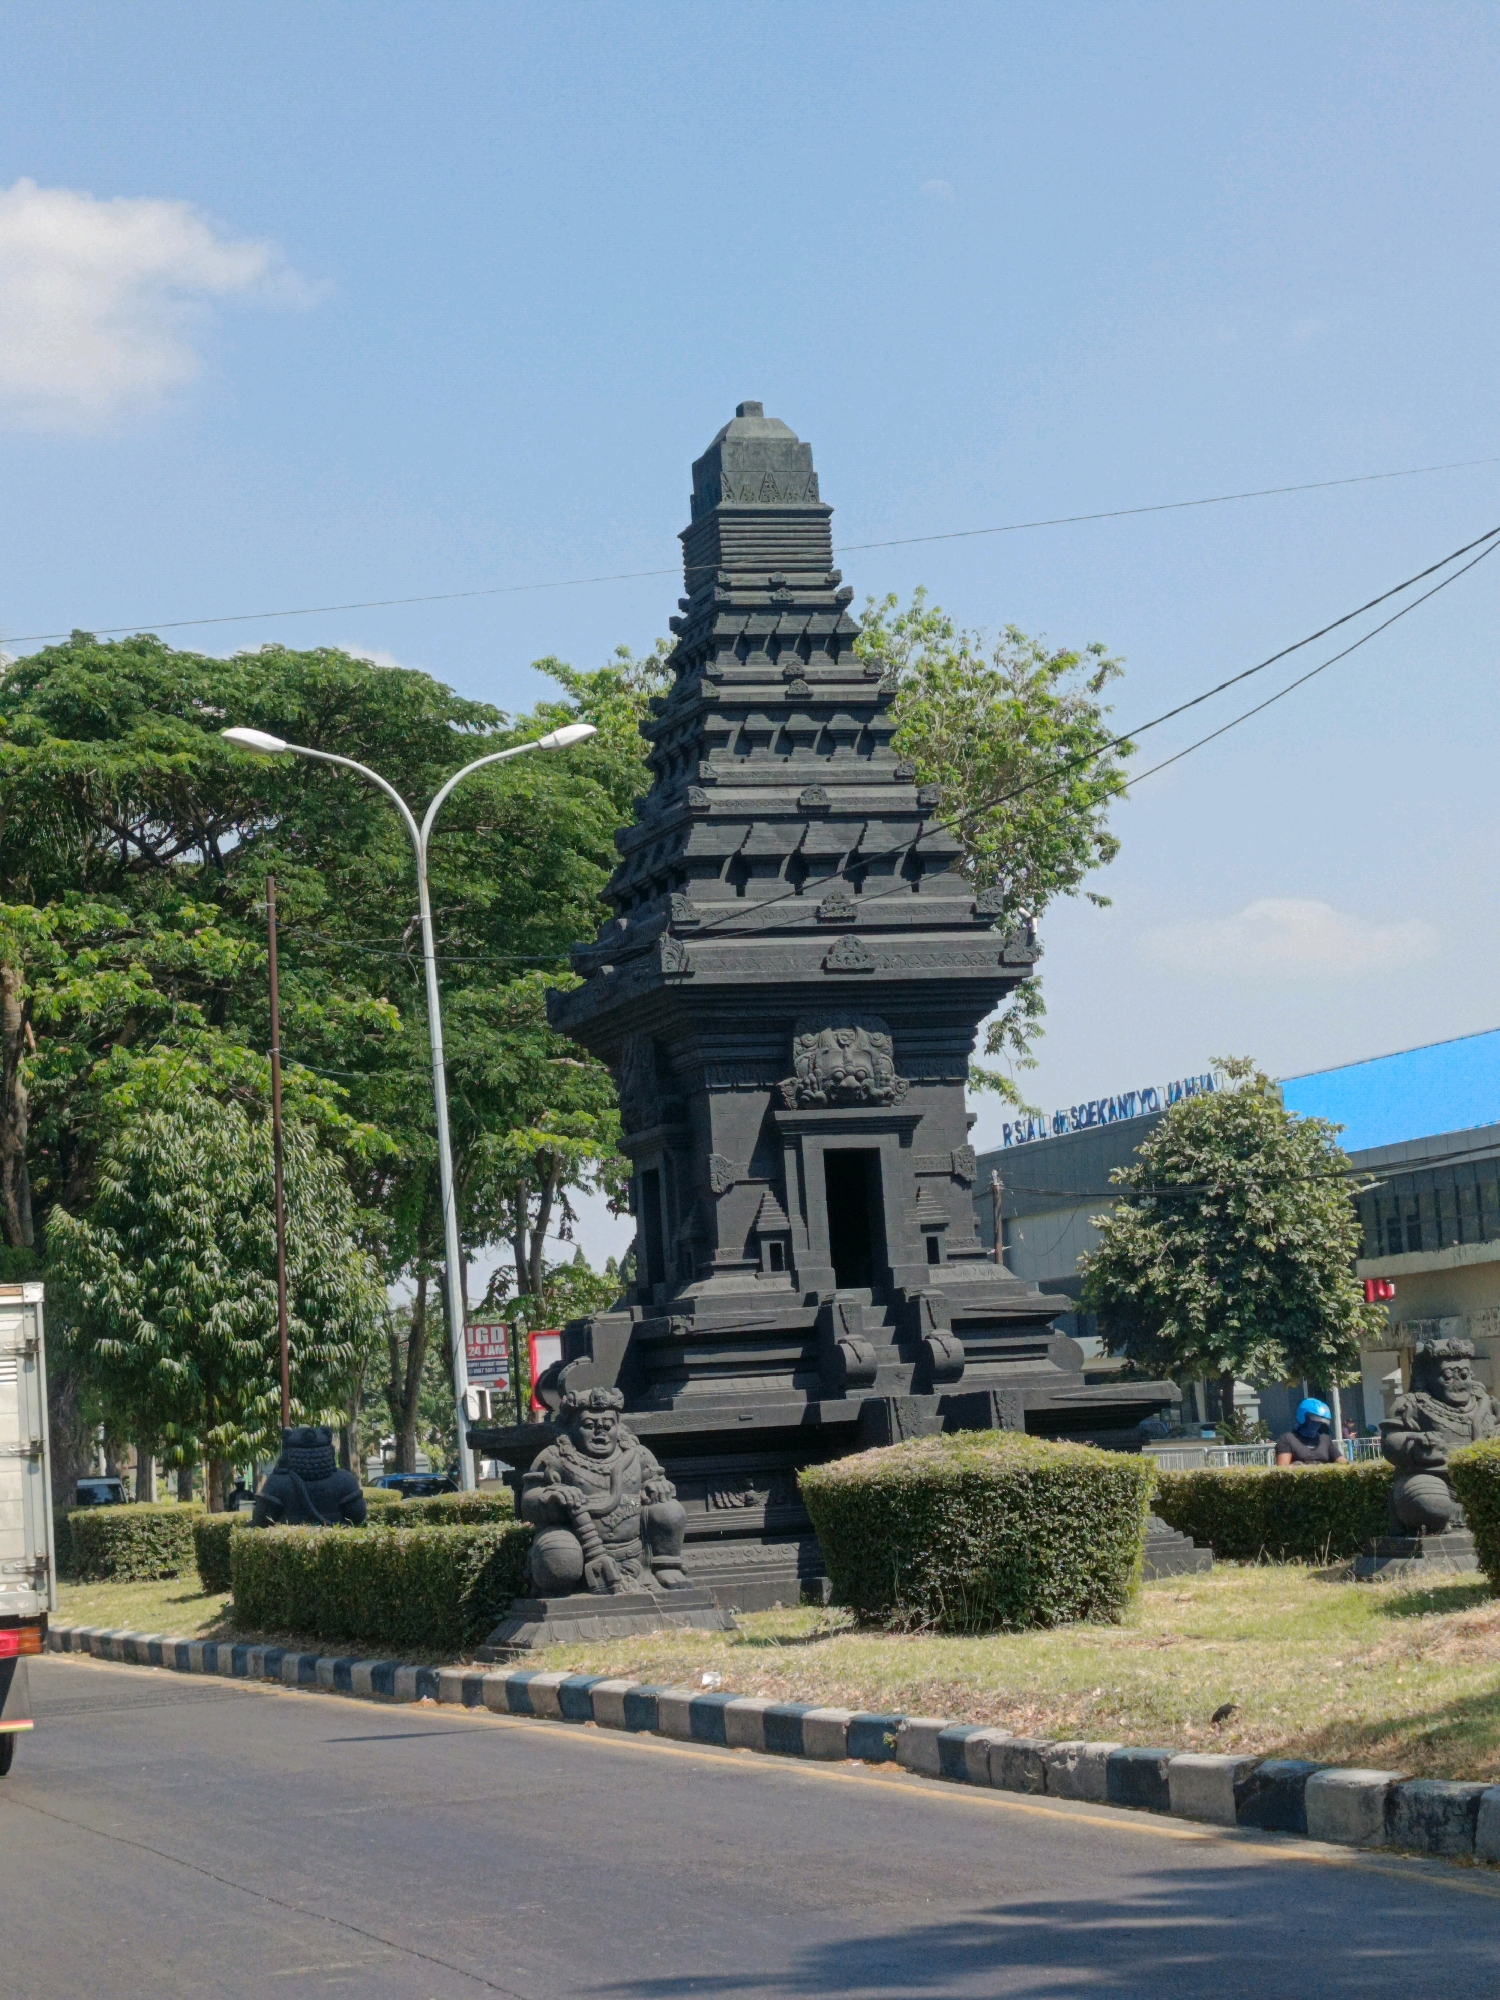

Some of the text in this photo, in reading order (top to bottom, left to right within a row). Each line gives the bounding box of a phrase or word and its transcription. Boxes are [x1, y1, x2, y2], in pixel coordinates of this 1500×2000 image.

[1070, 1087, 1159, 1131] SOEKANTYO
[467, 1327, 504, 1345] IGD
[468, 1345, 506, 1357] 24 JAM
